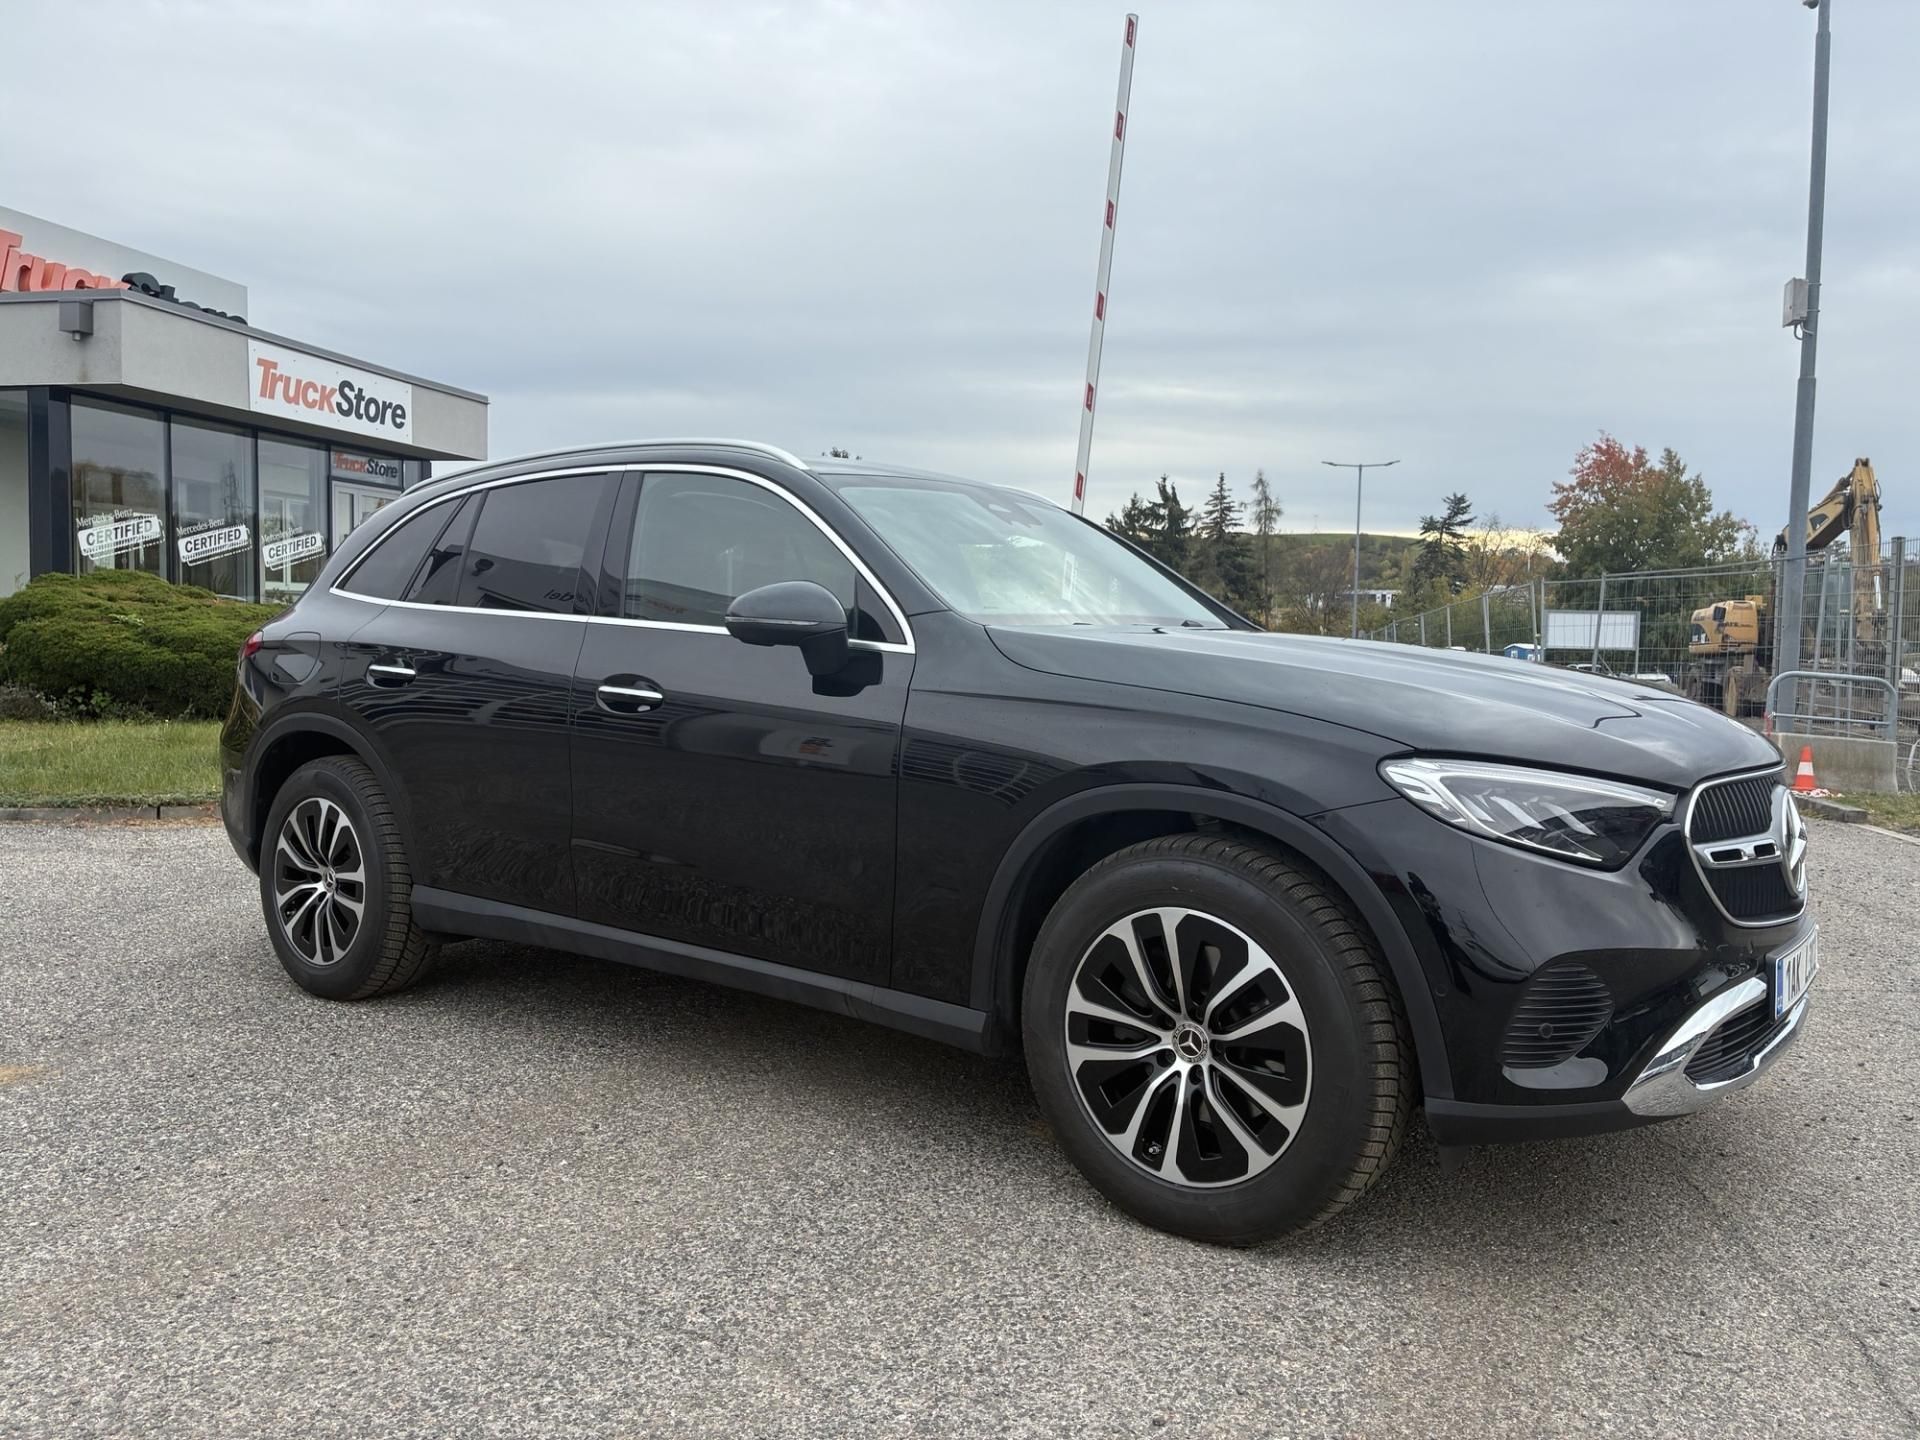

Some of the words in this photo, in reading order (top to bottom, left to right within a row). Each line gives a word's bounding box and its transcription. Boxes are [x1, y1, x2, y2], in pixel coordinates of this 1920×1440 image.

[256, 357, 406, 429] TruckStore
[76, 508, 133, 528] Mercedes-Benz
[176, 518, 225, 537] Mercedes-Benz
[86, 520, 153, 546] CERTIFIED
[184, 528, 242, 553] CERTIFIED
[268, 536, 317, 559] CERTIFIED
